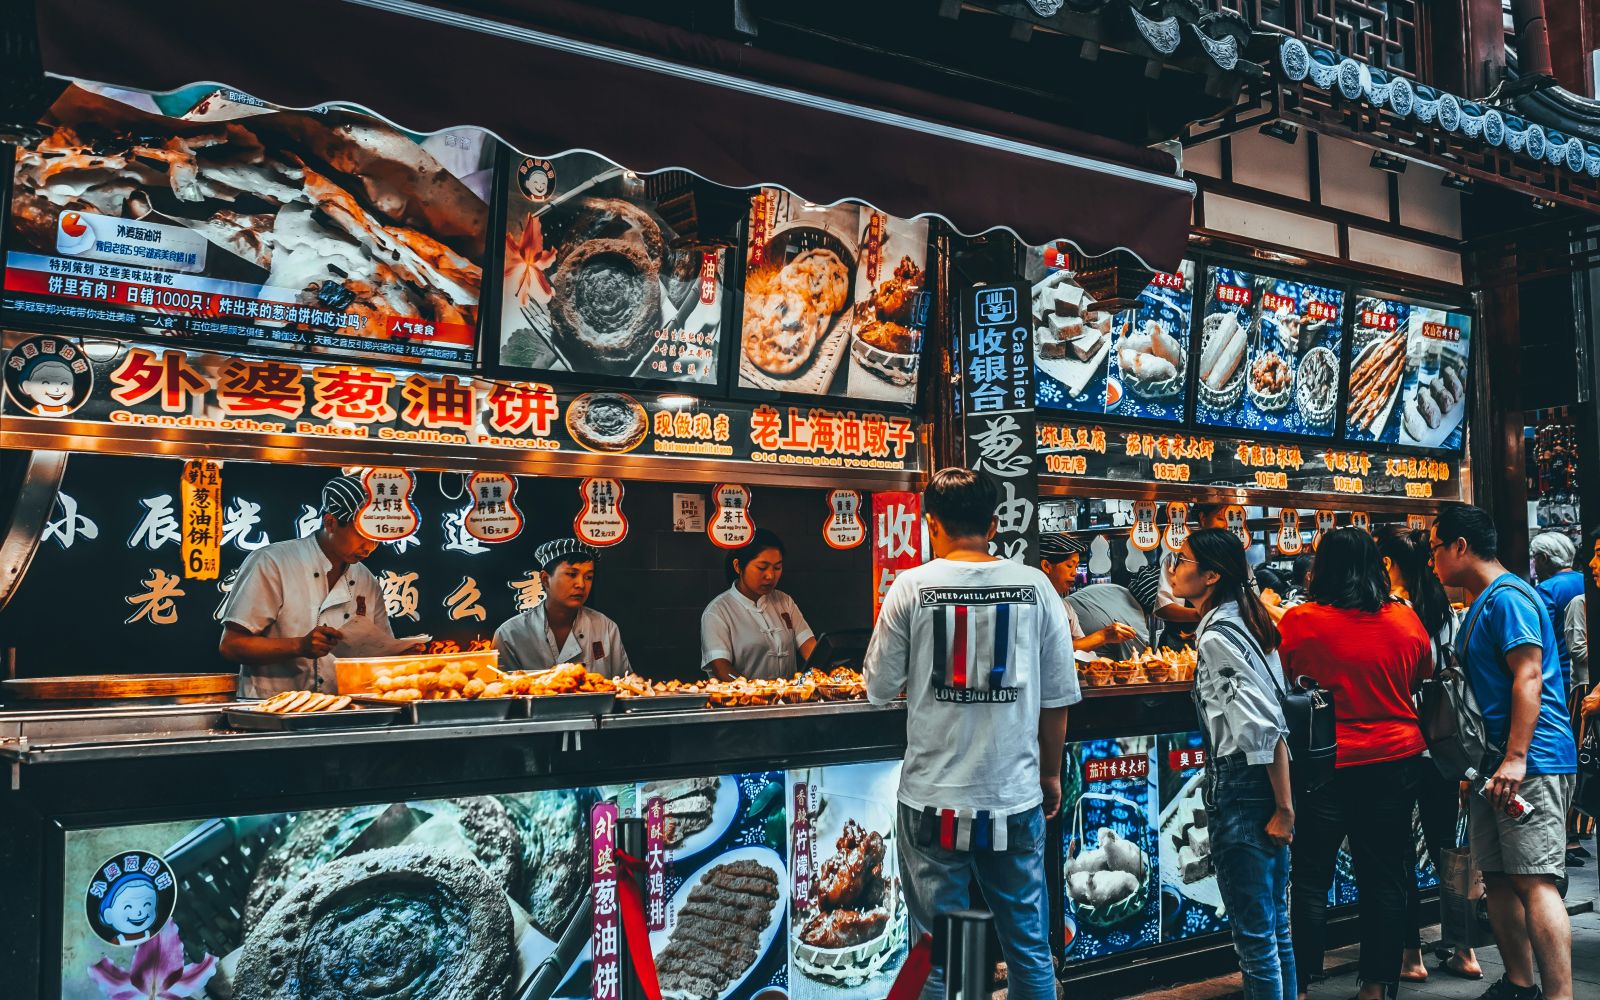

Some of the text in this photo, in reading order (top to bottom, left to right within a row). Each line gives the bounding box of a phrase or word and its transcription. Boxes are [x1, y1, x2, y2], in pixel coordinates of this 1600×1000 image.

[701, 253, 716, 300] 油饼
[391, 320, 436, 337] 人气美食
[968, 328, 1008, 411] 收银台
[1012, 327, 1029, 408] Cashier
[110, 348, 558, 437] 外婆葱油饼
[110, 411, 561, 450] Grandmother Baked Scallion Pancake
[653, 410, 730, 441] 现做现卖
[750, 404, 915, 458] 老上海油墩子
[1036, 424, 1107, 454] 炸臭豆腐
[750, 451, 777, 463] Old
[1126, 430, 1216, 462] 茄汁香米大虾
[1045, 455, 1087, 475] 10元/客
[376, 482, 399, 496] 黄金
[480, 486, 502, 498] 香辣
[724, 497, 743, 508] 五香
[187, 487, 214, 547] 葱油饼
[372, 498, 403, 512] 大虾球
[477, 500, 506, 515] 柠檬鸡
[723, 510, 743, 523] 茶干
[1138, 521, 1154, 533] 臭豆腐
[992, 688, 1018, 702] LOVE
[1089, 759, 1147, 779] 茄汁香米大虾
[796, 788, 809, 902] 香辣柠檬鸡
[649, 800, 664, 925] 香酥大鸡排
[594, 811, 618, 999] 外婆葱油饼
